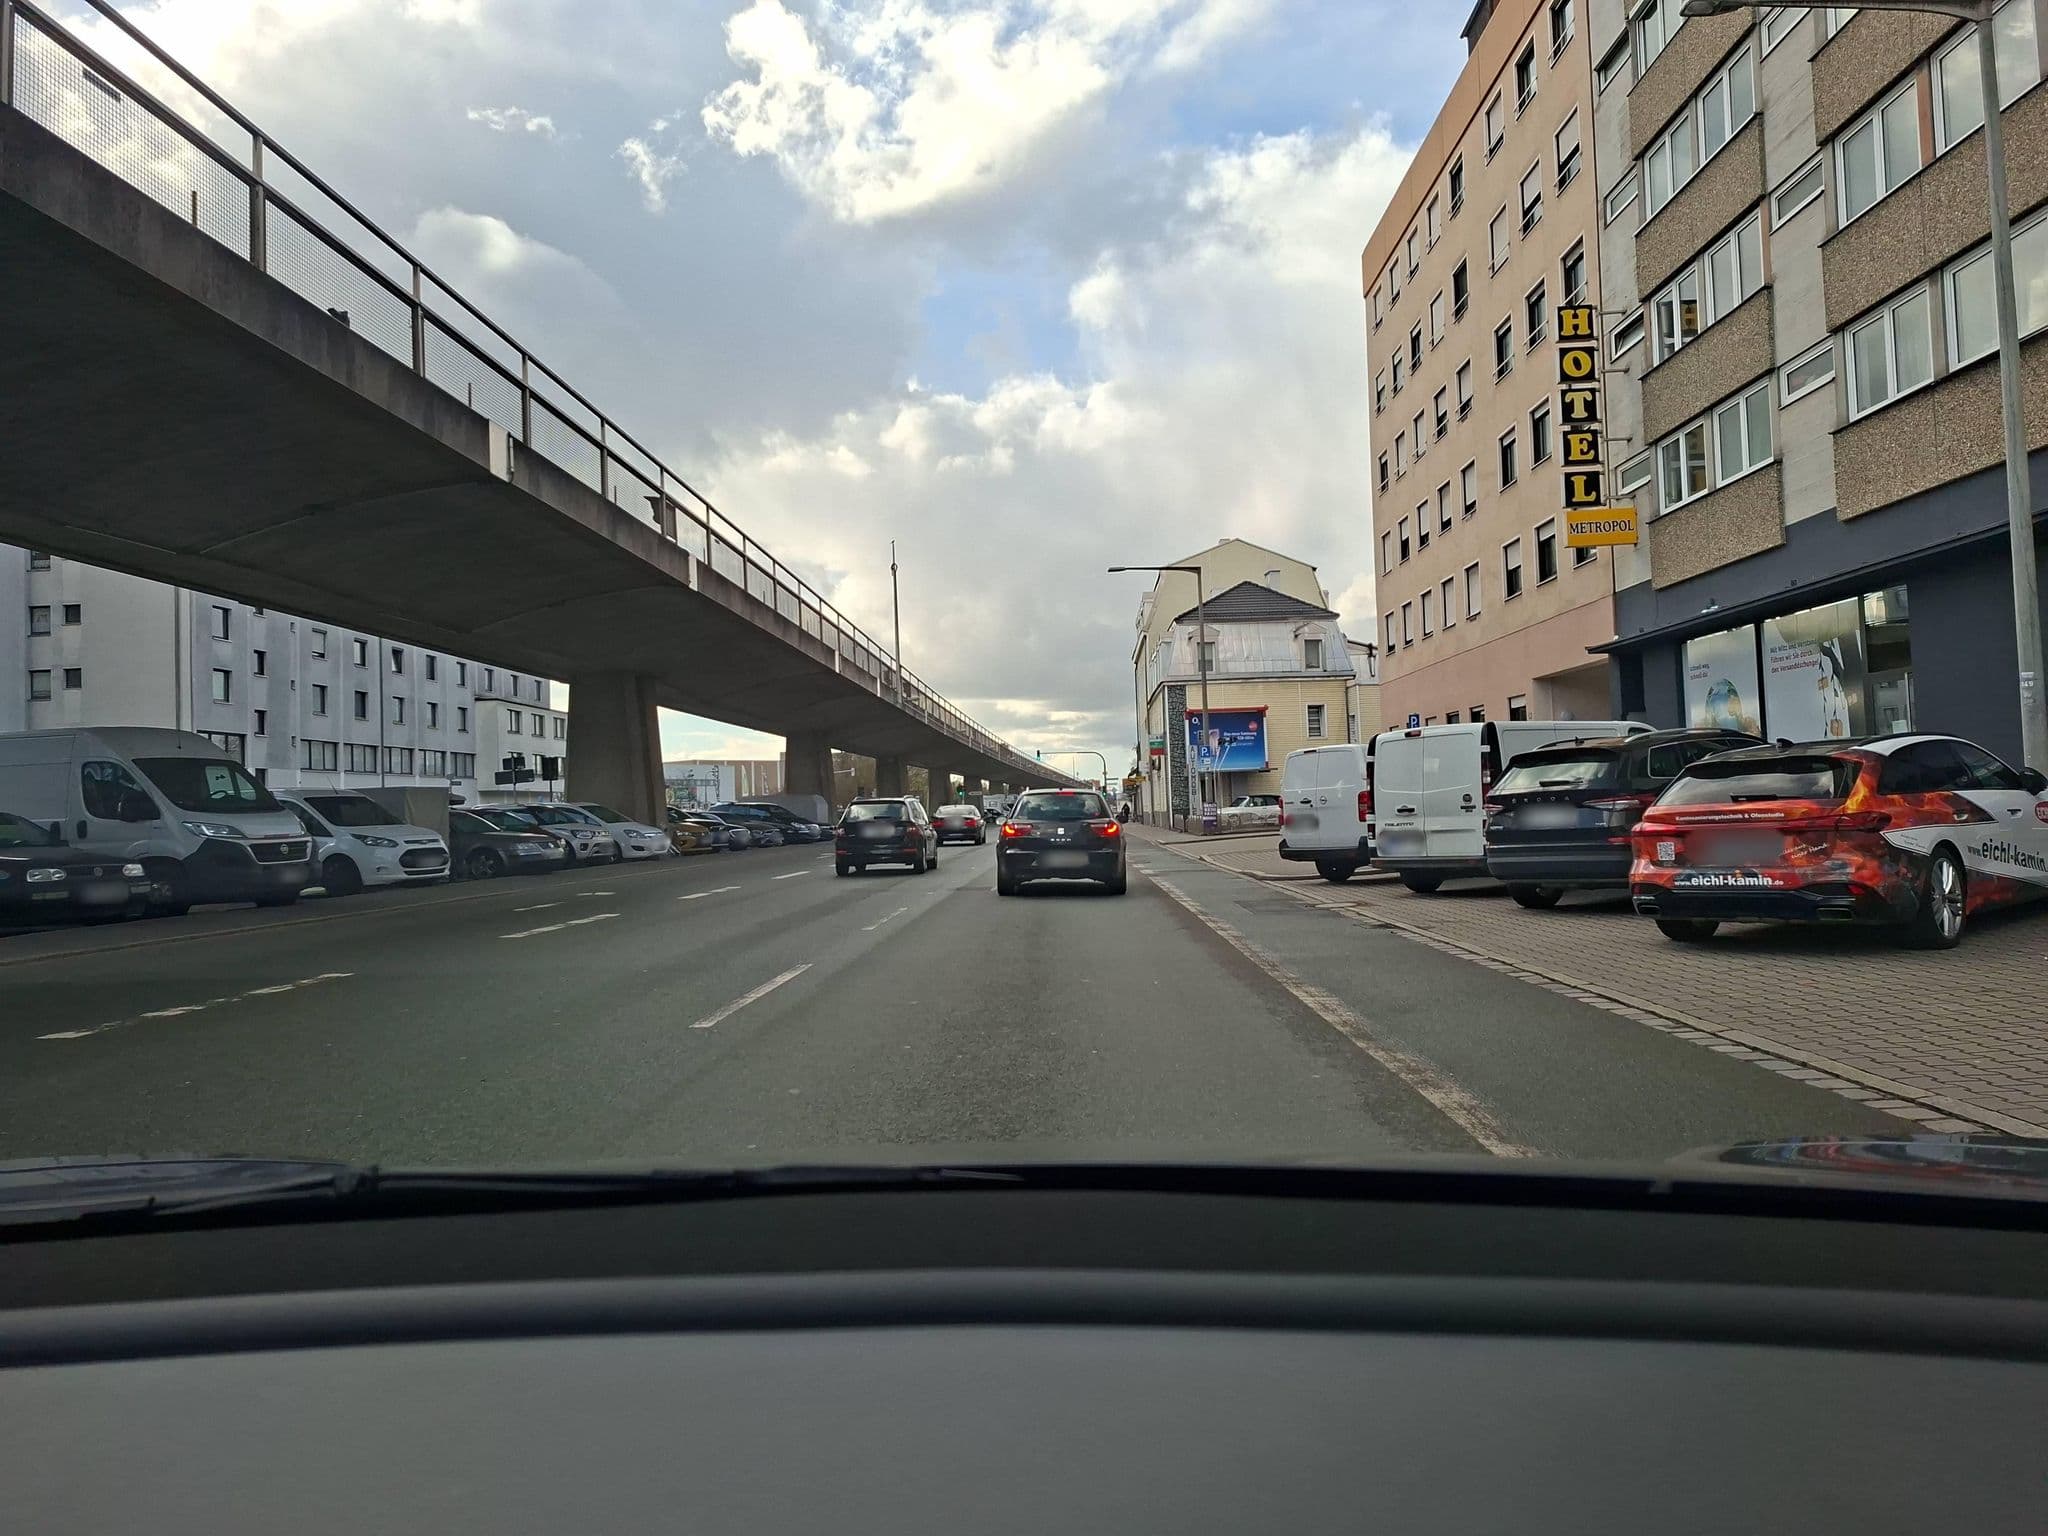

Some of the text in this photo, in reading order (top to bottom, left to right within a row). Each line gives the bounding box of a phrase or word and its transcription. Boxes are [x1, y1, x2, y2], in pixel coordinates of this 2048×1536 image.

[1560, 308, 1596, 503] HOTEL
[1569, 516, 1634, 534] METROPOL
[1674, 874, 1784, 887] www.eichl-kamin.de
